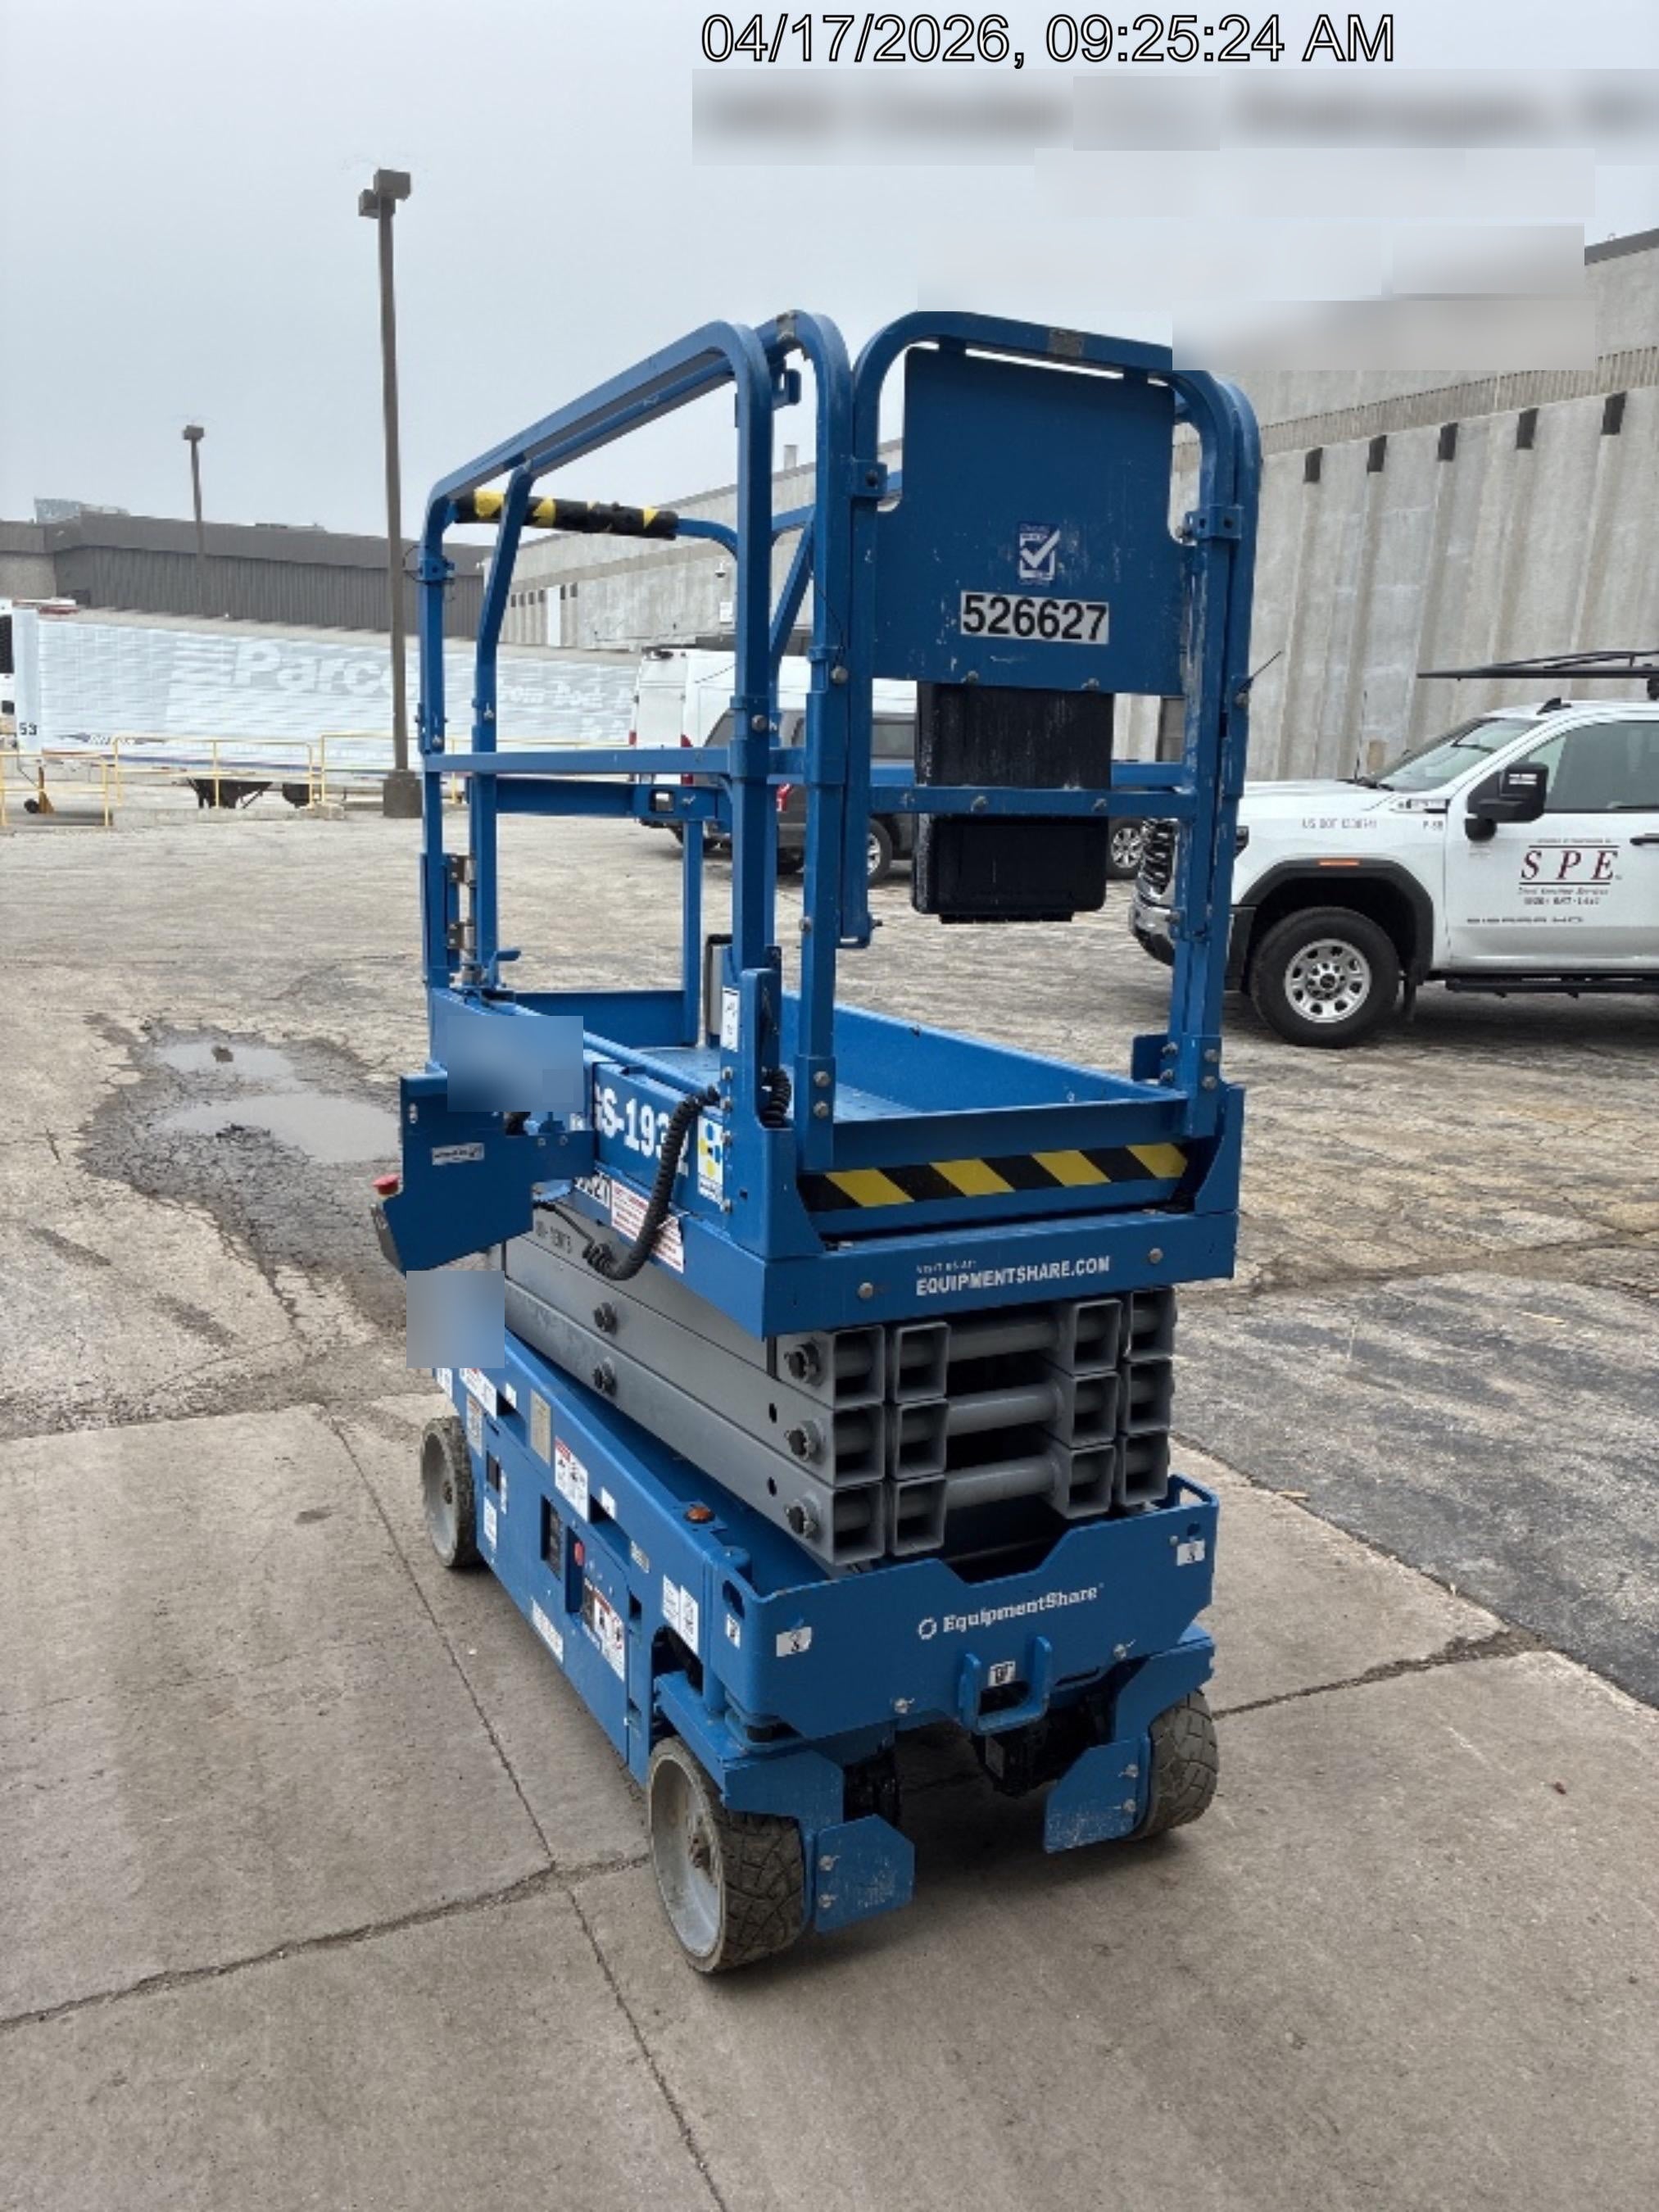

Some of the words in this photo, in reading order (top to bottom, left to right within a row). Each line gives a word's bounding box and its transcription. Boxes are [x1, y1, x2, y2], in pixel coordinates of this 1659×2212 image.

[963, 594, 1107, 641] 526627
[19, 722, 38, 736] 53
[916, 1255, 1111, 1296] EQUIPMENTSHARE.COM
[943, 1586, 1098, 1633] EquipmentShare
